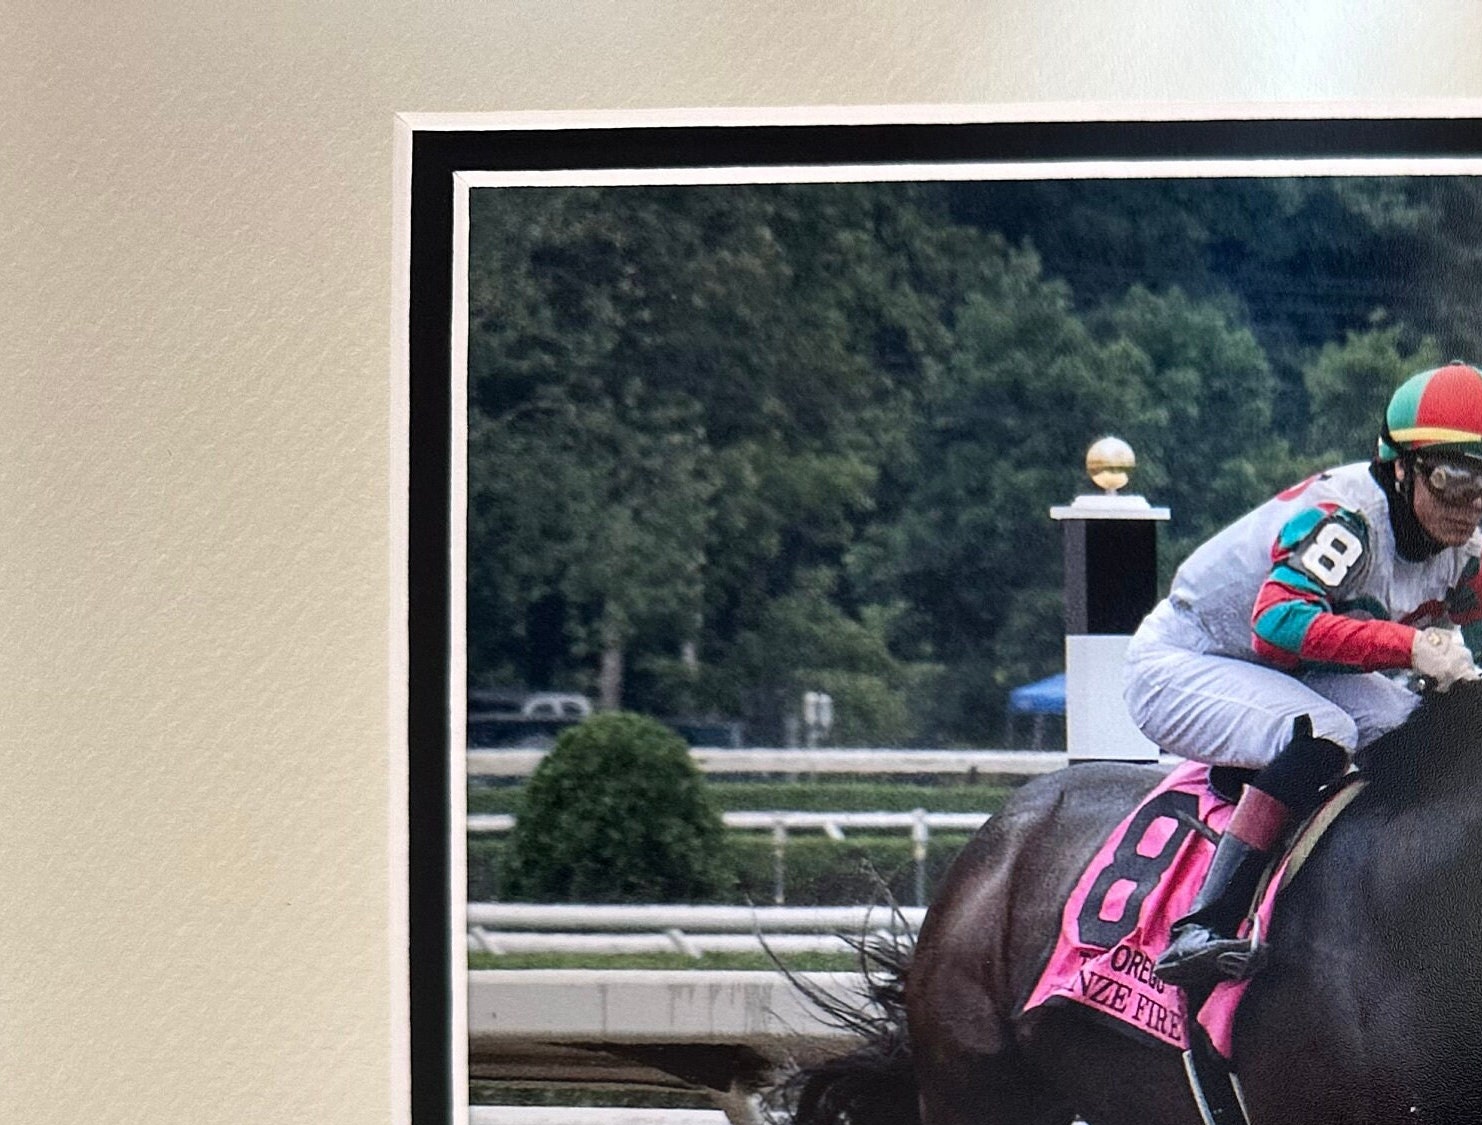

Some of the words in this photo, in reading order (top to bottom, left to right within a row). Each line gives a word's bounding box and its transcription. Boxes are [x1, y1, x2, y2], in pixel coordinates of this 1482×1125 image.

[1302, 523, 1363, 587] 8
[1078, 789, 1202, 950] 8
[1131, 992, 1184, 1042] FIRE
